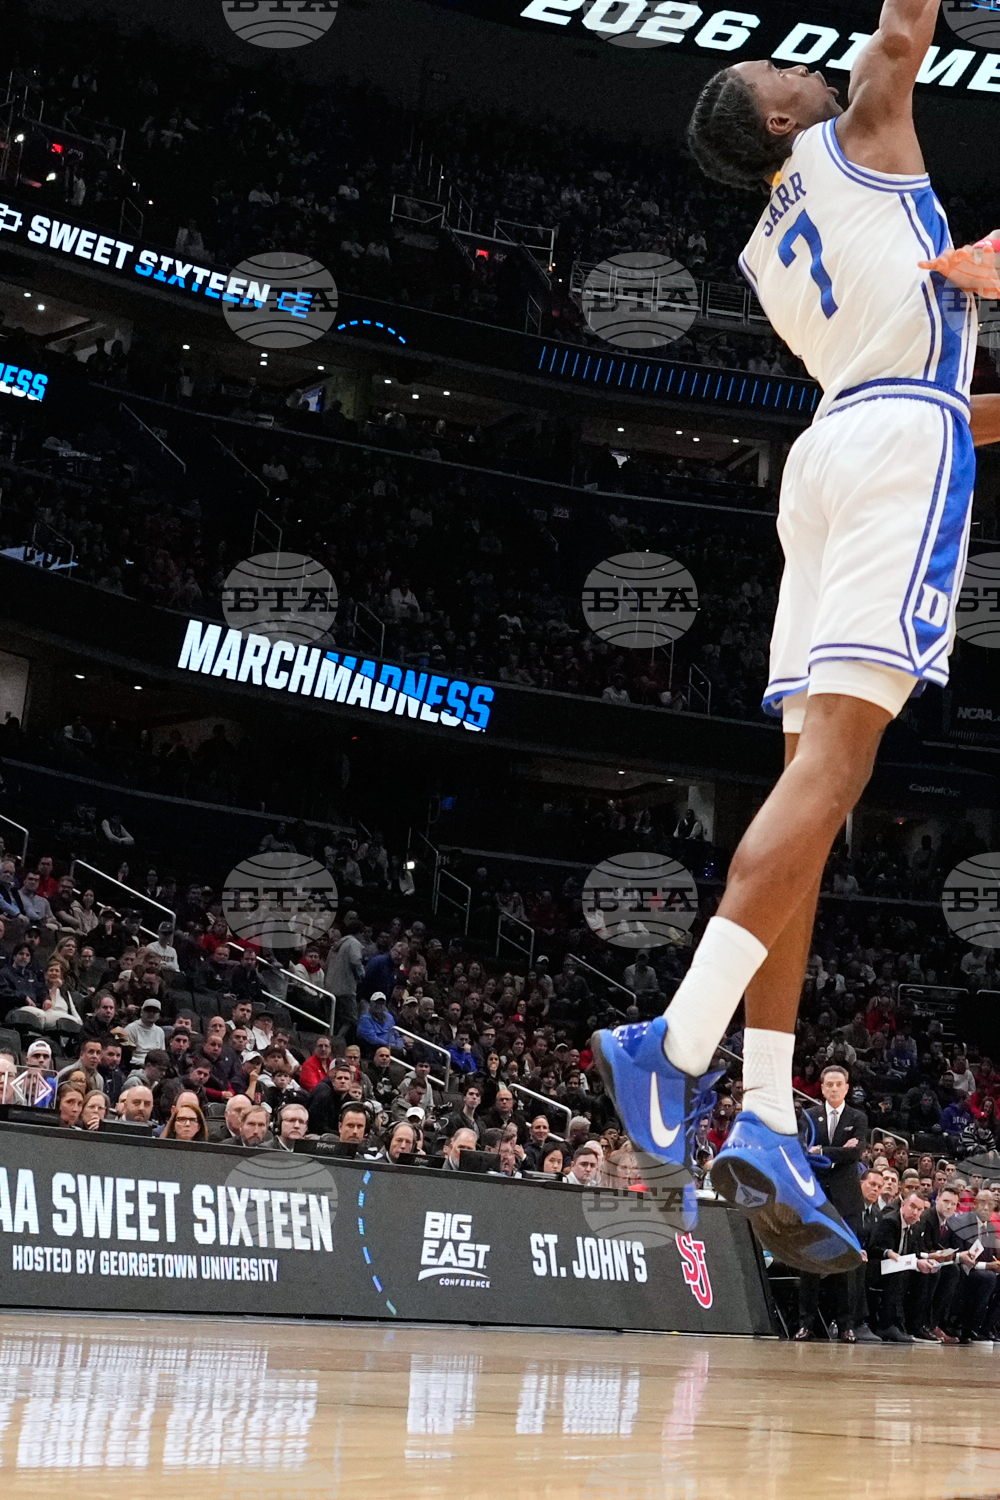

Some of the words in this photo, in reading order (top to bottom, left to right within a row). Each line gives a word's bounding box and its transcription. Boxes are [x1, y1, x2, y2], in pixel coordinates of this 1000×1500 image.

[27, 214, 134, 269] SWEET
[135, 249, 271, 309] SIXTEEN
[778, 208, 839, 320] 7
[177, 619, 495, 733] MARCHMADNESS
[52, 1171, 181, 1243] SWEET
[192, 1184, 334, 1252] SIXTEEN
[423, 1211, 472, 1241] BIG
[12, 1244, 72, 1273] HOSTED
[76, 1249, 96, 1274] BY
[99, 1250, 198, 1278] GEORGETOWN
[201, 1256, 279, 1282] UNIVERSITY
[421, 1240, 490, 1269] EAST
[530, 1233, 567, 1277] ST.
[572, 1236, 648, 1283] JOHN'S
[439, 1277, 491, 1288] CONFERENCE
